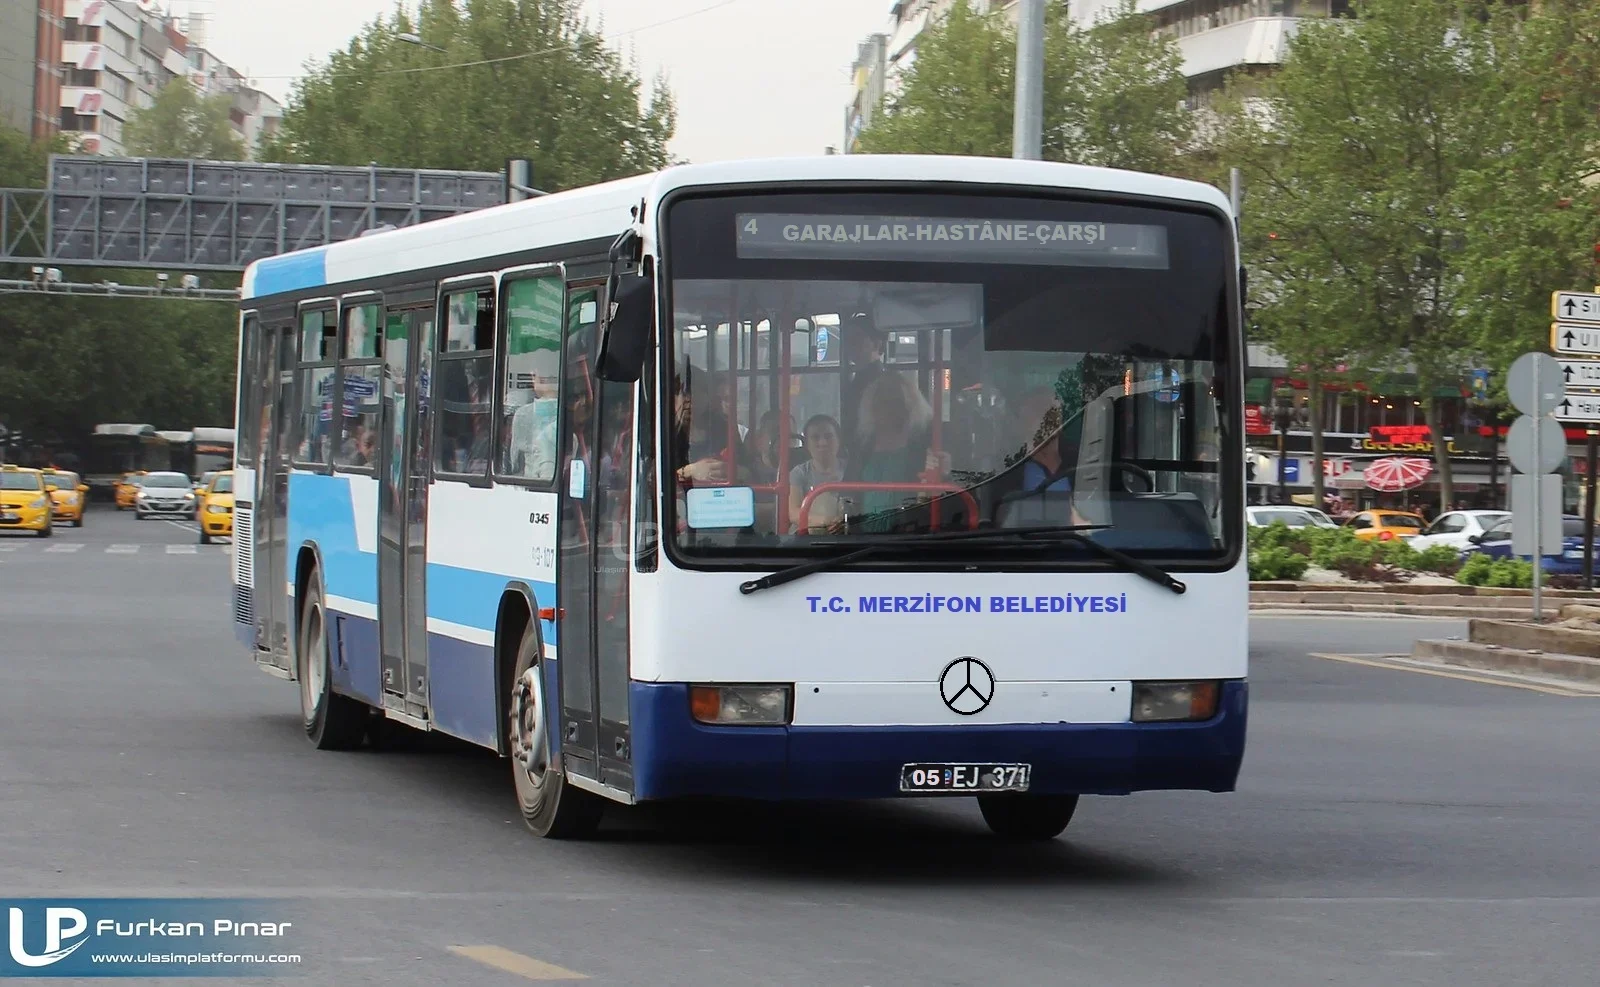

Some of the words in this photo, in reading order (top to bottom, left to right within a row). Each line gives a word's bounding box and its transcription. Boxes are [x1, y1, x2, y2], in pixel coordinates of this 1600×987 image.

[743, 219, 758, 235] 4
[806, 596, 850, 613] T.C.
[859, 592, 981, 613] MERZİFON
[990, 592, 1126, 613] BELEDİYESİ
[912, 769, 940, 786] 05
[953, 766, 979, 788] EJ
[991, 766, 1027, 788] 371
